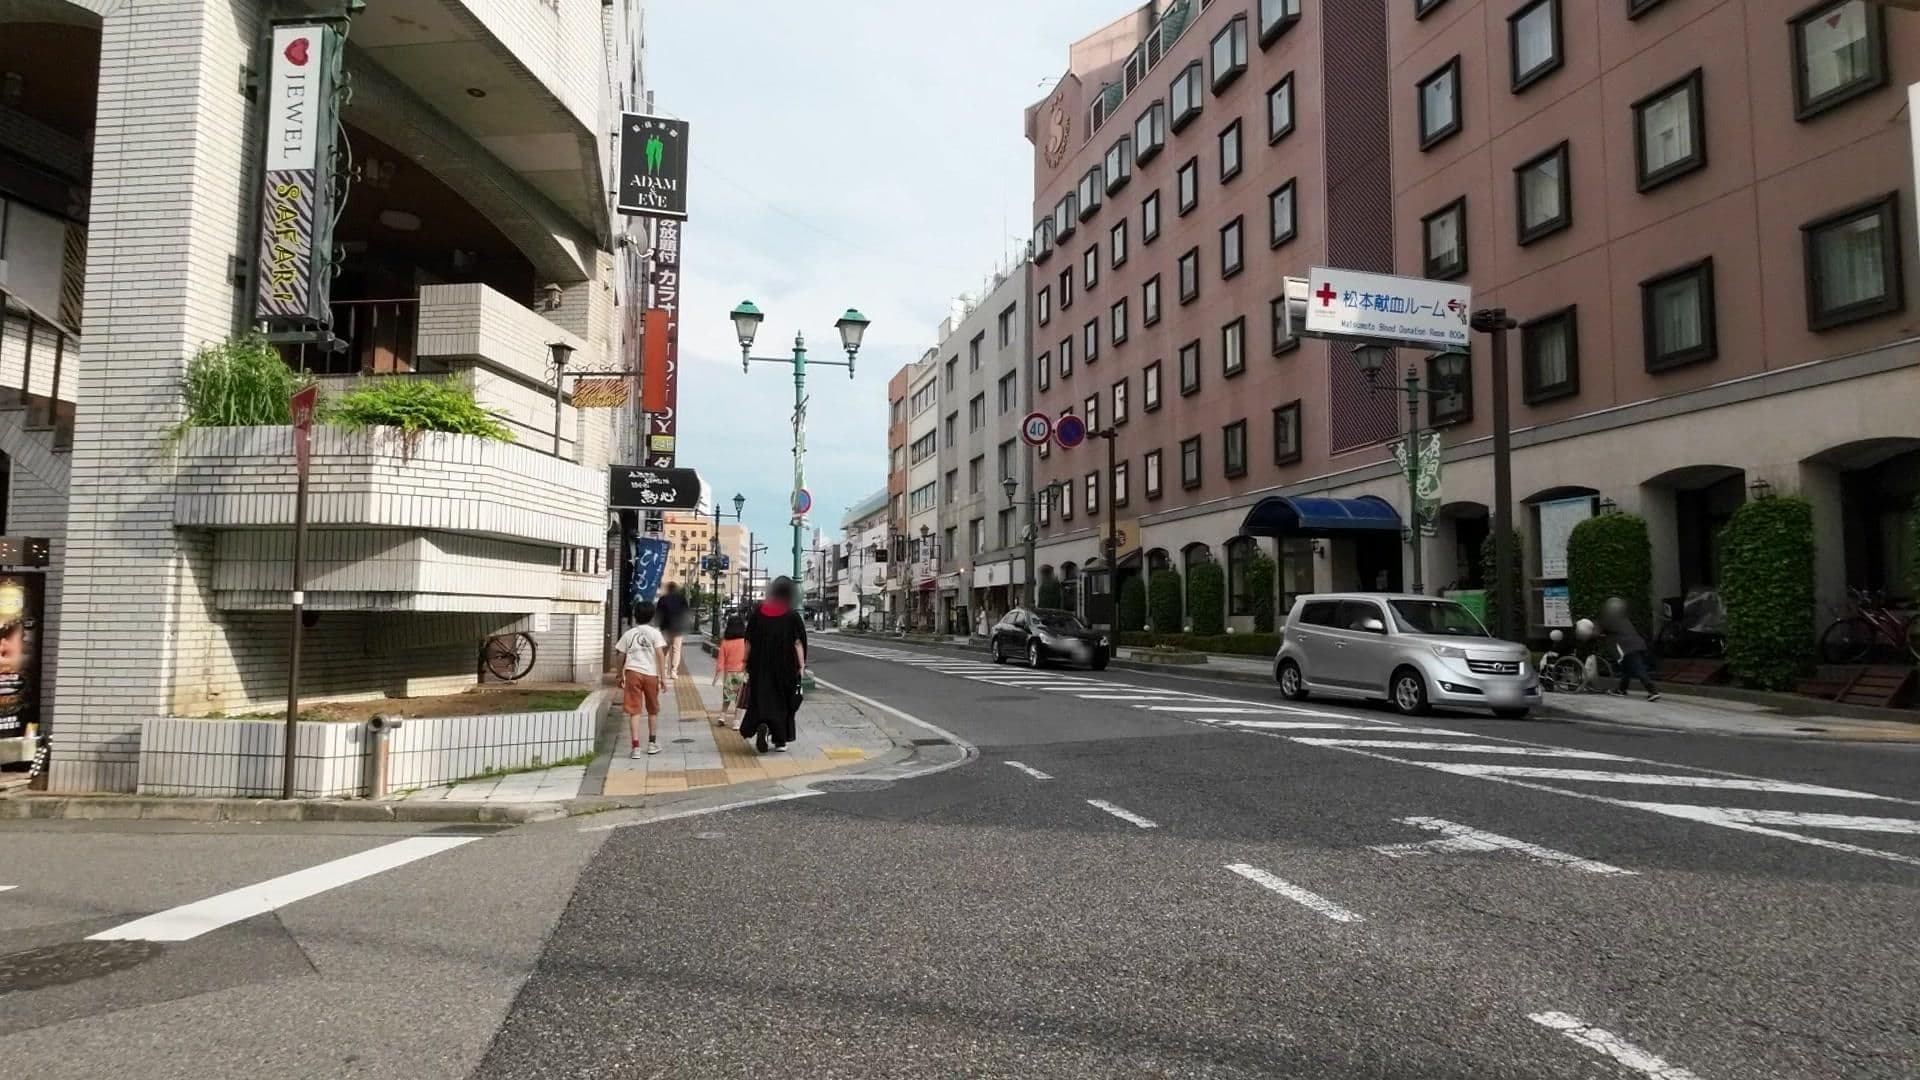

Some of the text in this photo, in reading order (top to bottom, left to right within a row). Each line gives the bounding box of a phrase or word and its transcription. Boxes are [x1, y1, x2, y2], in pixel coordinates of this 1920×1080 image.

[283, 74, 306, 160] JEWEL
[630, 174, 677, 191] ADAM
[638, 192, 668, 208] EVE
[271, 183, 300, 302] SAFARI
[1342, 290, 1446, 318] 松本献血ルーム
[1378, 322, 1396, 333] Blood
[1399, 325, 1426, 336] Donation
[1029, 422, 1046, 437] 40
